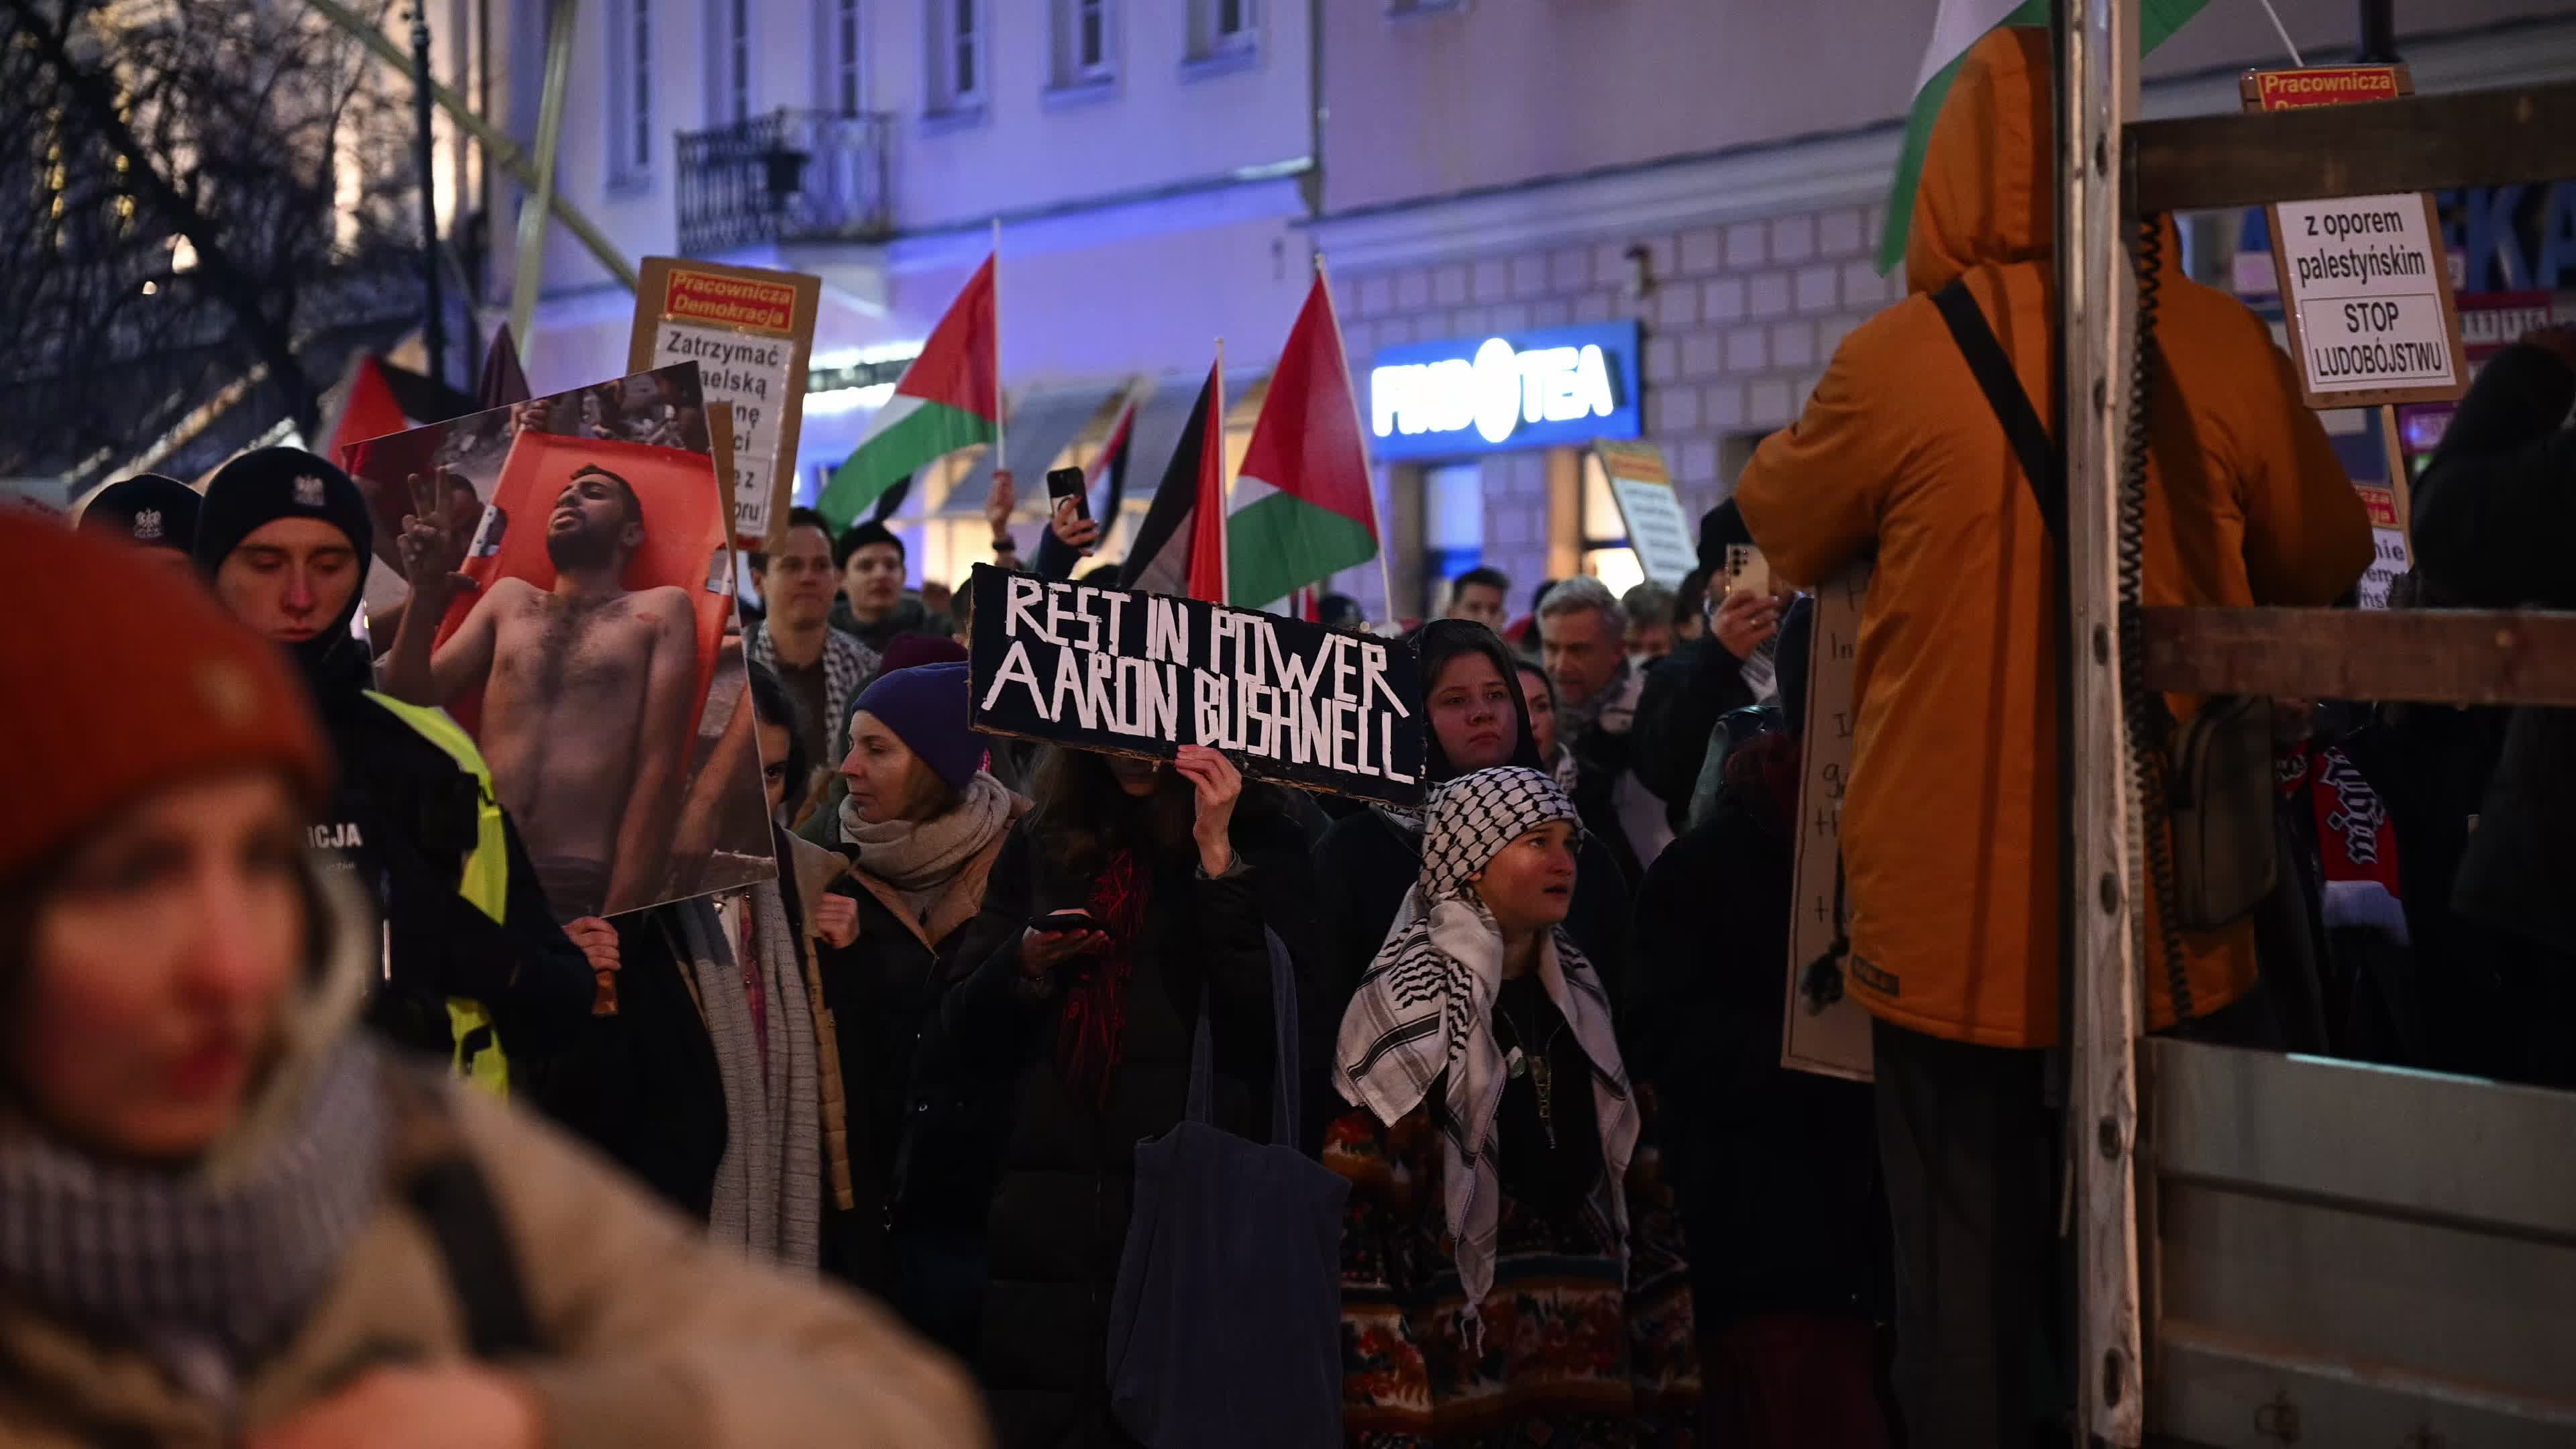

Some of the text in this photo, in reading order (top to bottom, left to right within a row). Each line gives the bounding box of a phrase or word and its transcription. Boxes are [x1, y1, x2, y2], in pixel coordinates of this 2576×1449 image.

[2265, 72, 2391, 94] Pracownicza
[2304, 209, 2404, 239] z oporem
[2297, 243, 2426, 288] palestyńskim
[672, 270, 790, 304] Pracownicza
[675, 293, 786, 326] Demokracja
[2344, 300, 2400, 333] STOP
[666, 330, 779, 366] Zatrzymać
[2314, 337, 2443, 377] LUDOBÓJSTWU
[701, 368, 767, 401] aelską
[1005, 575, 1411, 718] REST IN POWER
[980, 639, 1415, 784] AARON BUSHNELL
[306, 822, 364, 849] ICJA
